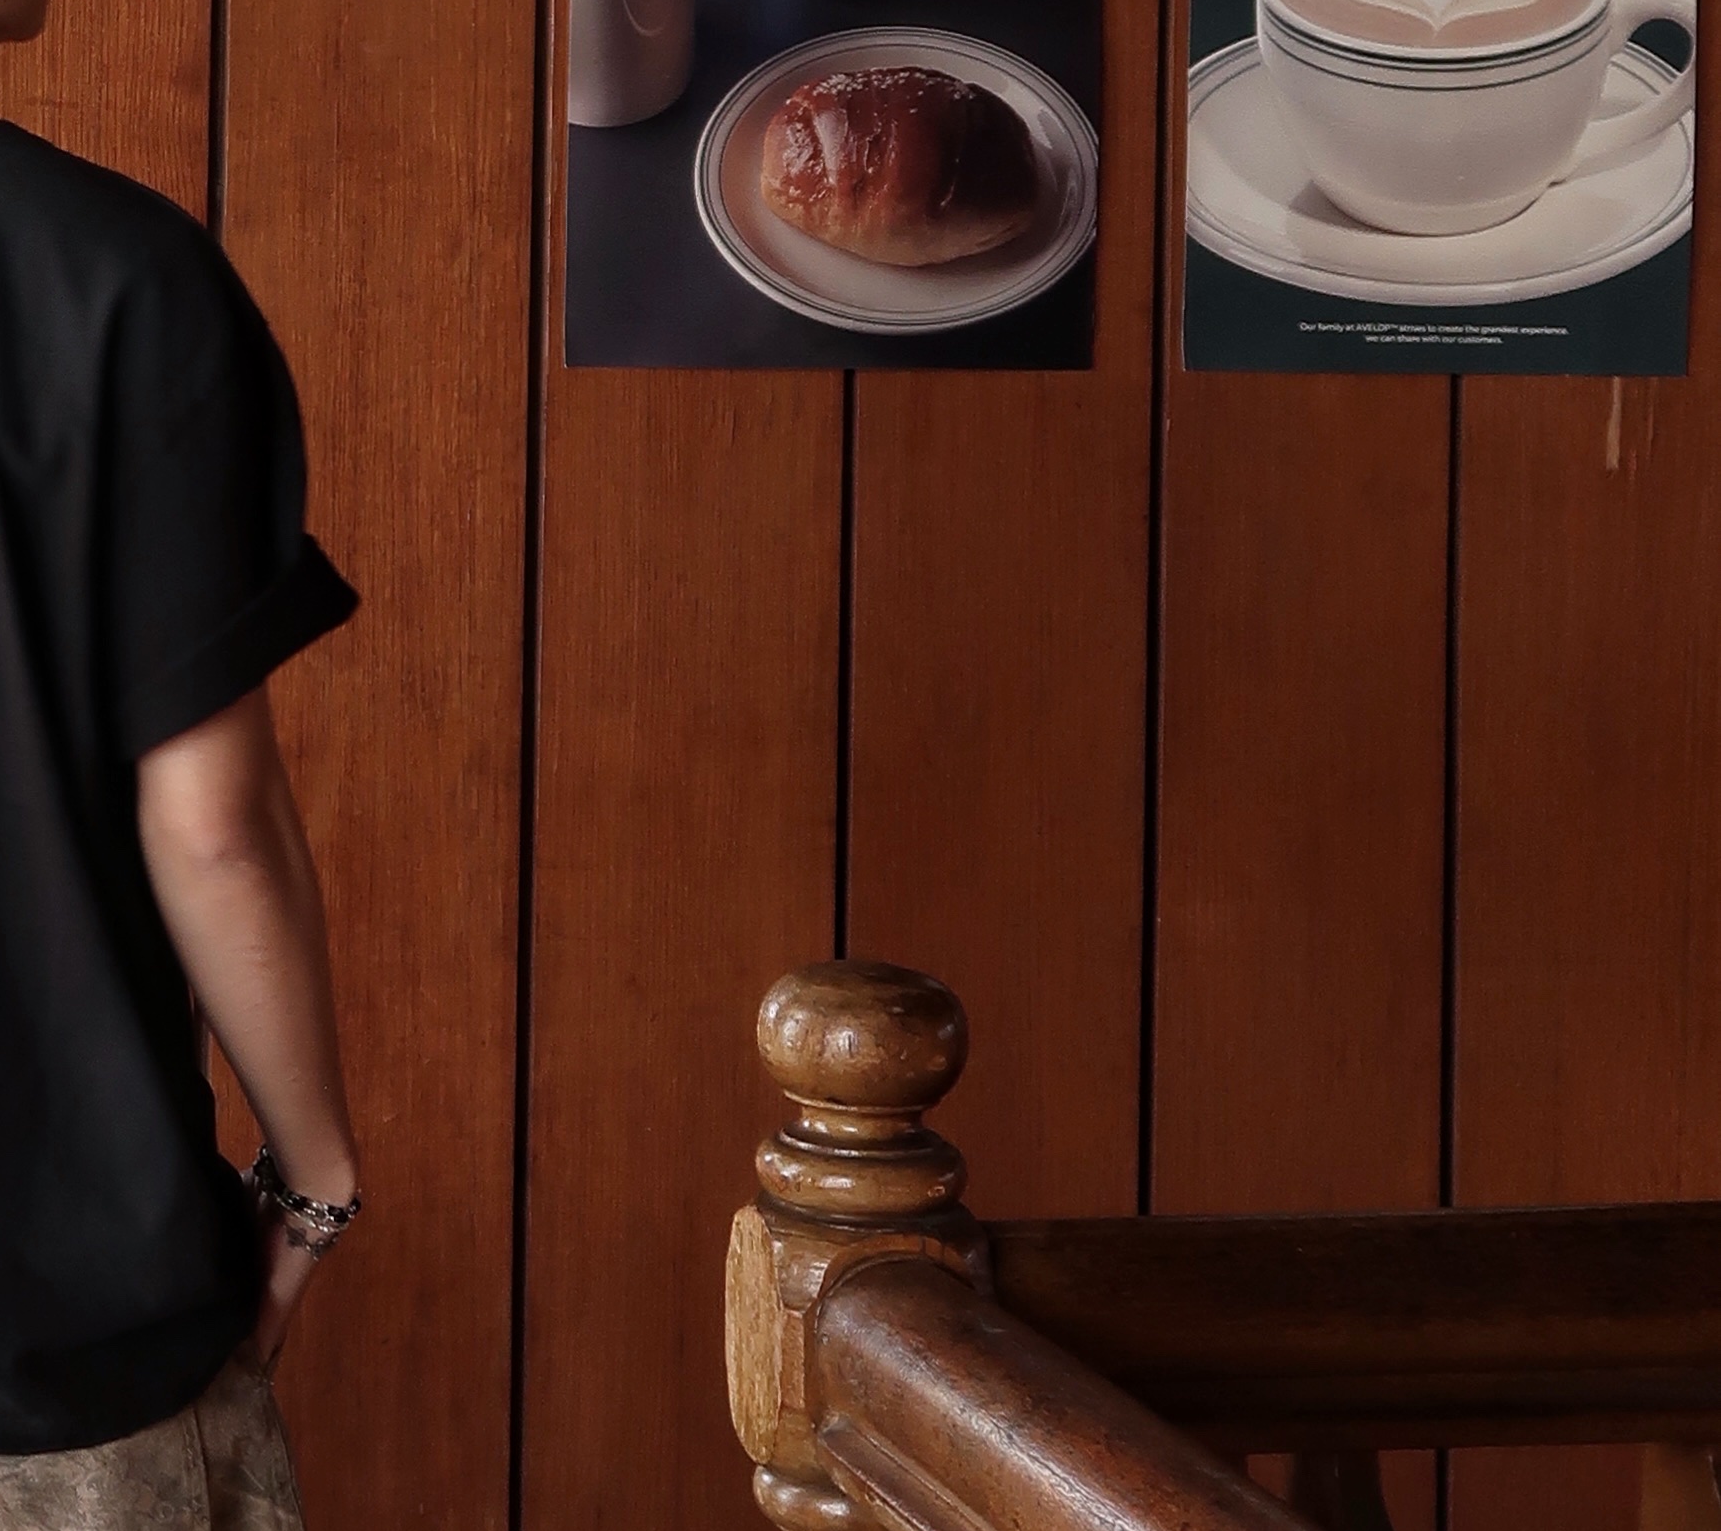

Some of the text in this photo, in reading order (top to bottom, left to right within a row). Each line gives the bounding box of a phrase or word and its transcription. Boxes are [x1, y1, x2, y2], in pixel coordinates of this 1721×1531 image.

[1300, 322, 1316, 331] Our
[1318, 322, 1344, 333] family
[1397, 334, 1420, 343] share
[1421, 334, 1440, 343] with
[1441, 336, 1456, 344] our
